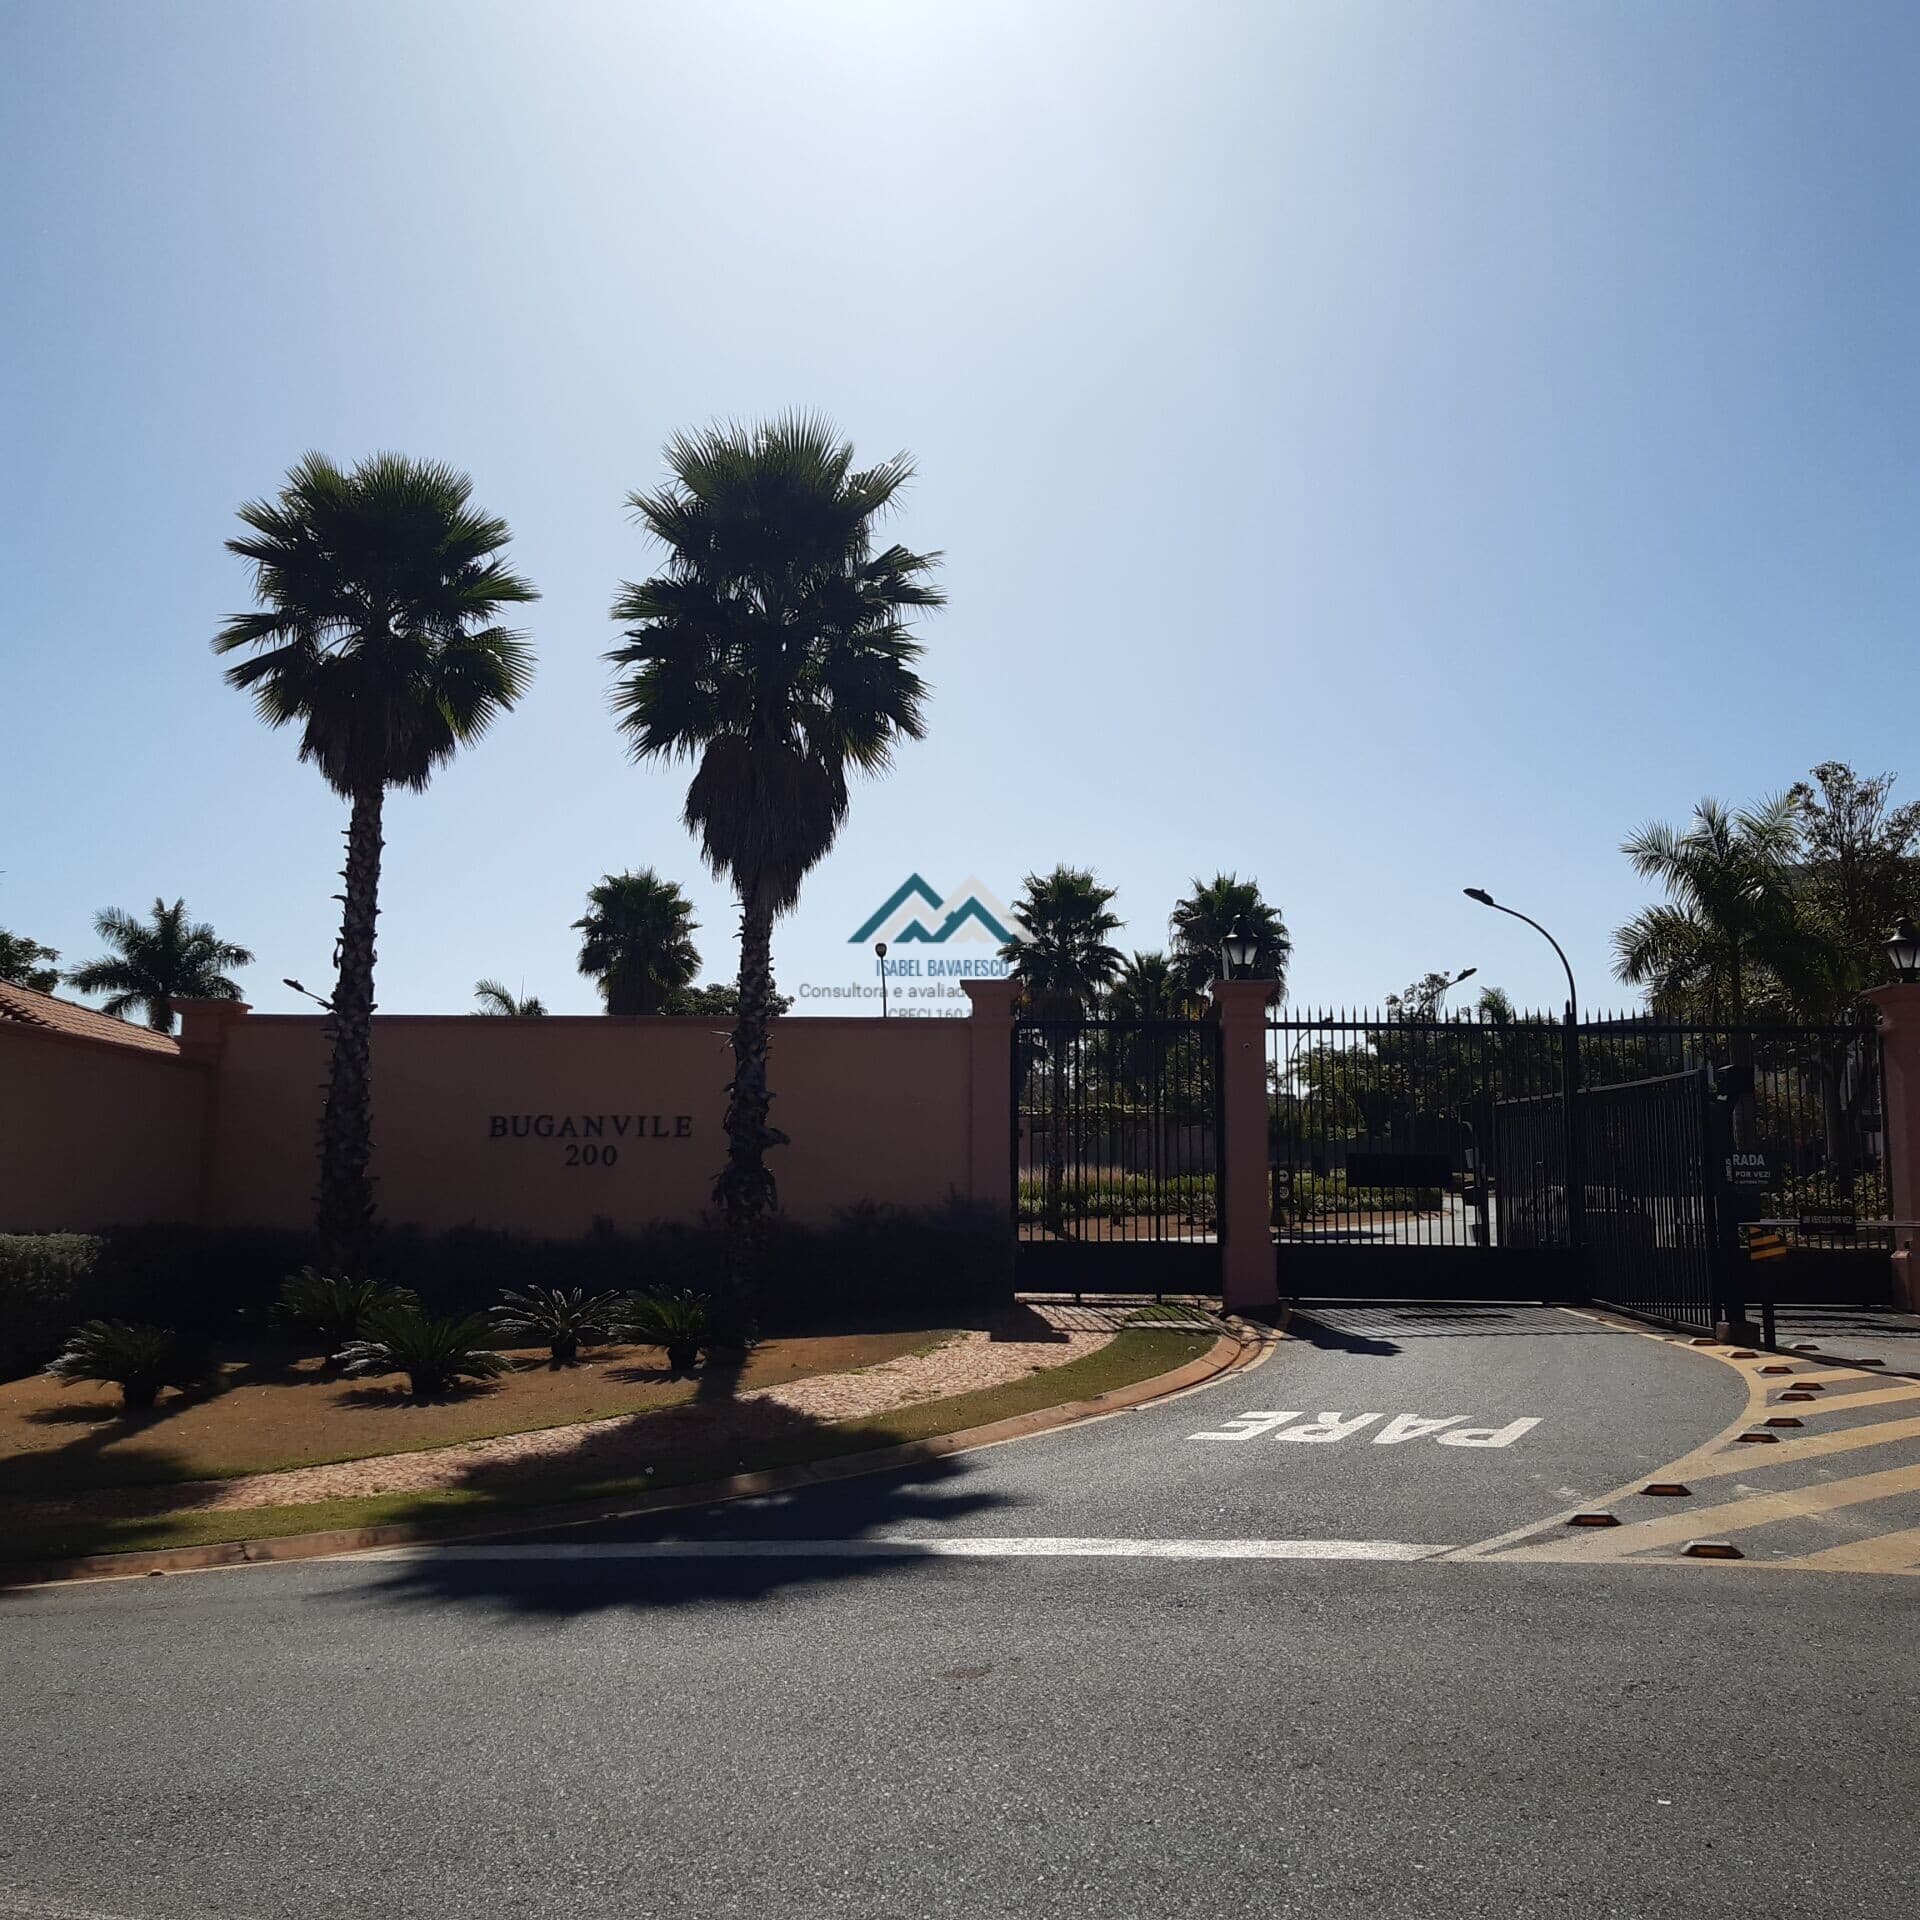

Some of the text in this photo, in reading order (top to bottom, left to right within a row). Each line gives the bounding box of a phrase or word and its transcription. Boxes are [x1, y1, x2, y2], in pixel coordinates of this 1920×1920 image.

[488, 1115, 693, 1138] BUGANVILE
[565, 1144, 618, 1167] 200
[1186, 1411, 1544, 1448] PARE
